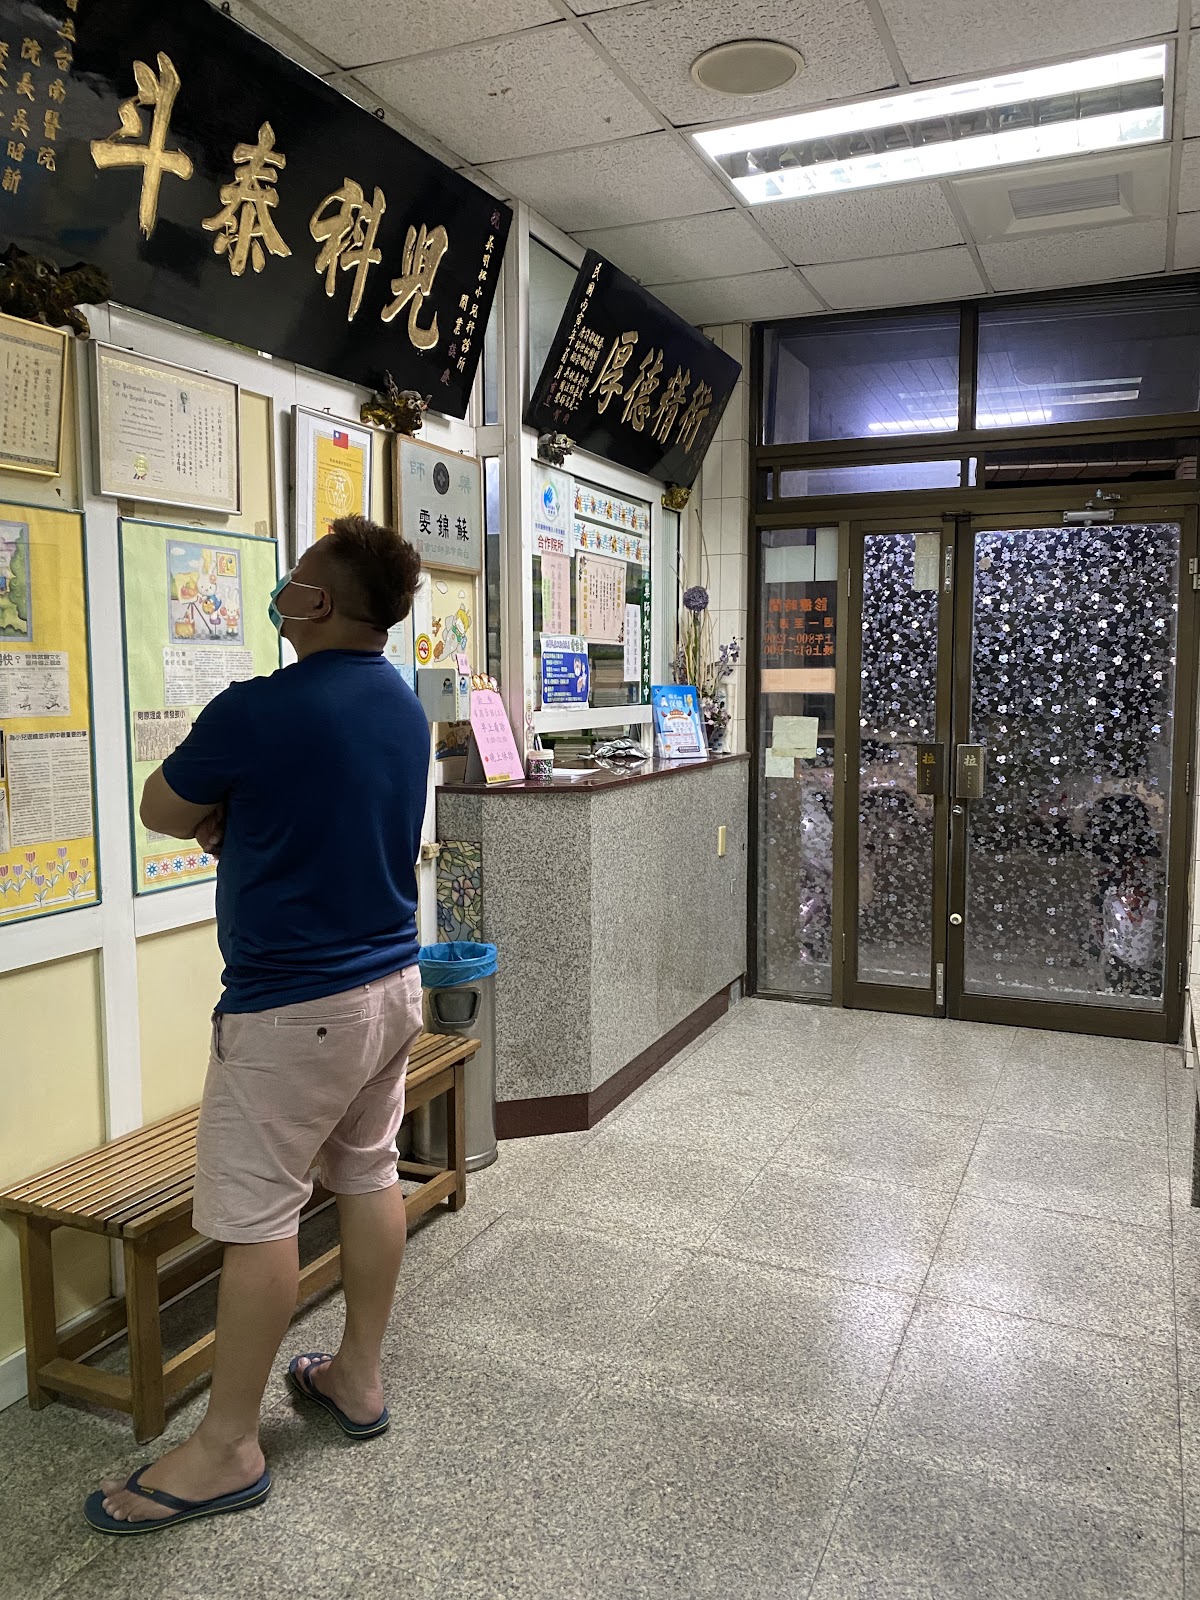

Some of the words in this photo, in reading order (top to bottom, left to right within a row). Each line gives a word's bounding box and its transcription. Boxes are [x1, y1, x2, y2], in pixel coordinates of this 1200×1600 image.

[537, 536, 564, 553] 合作院所
[643, 582, 651, 702] 藥師執行業務中
[922, 752, 936, 764] 拉
[963, 754, 978, 767] 拉
